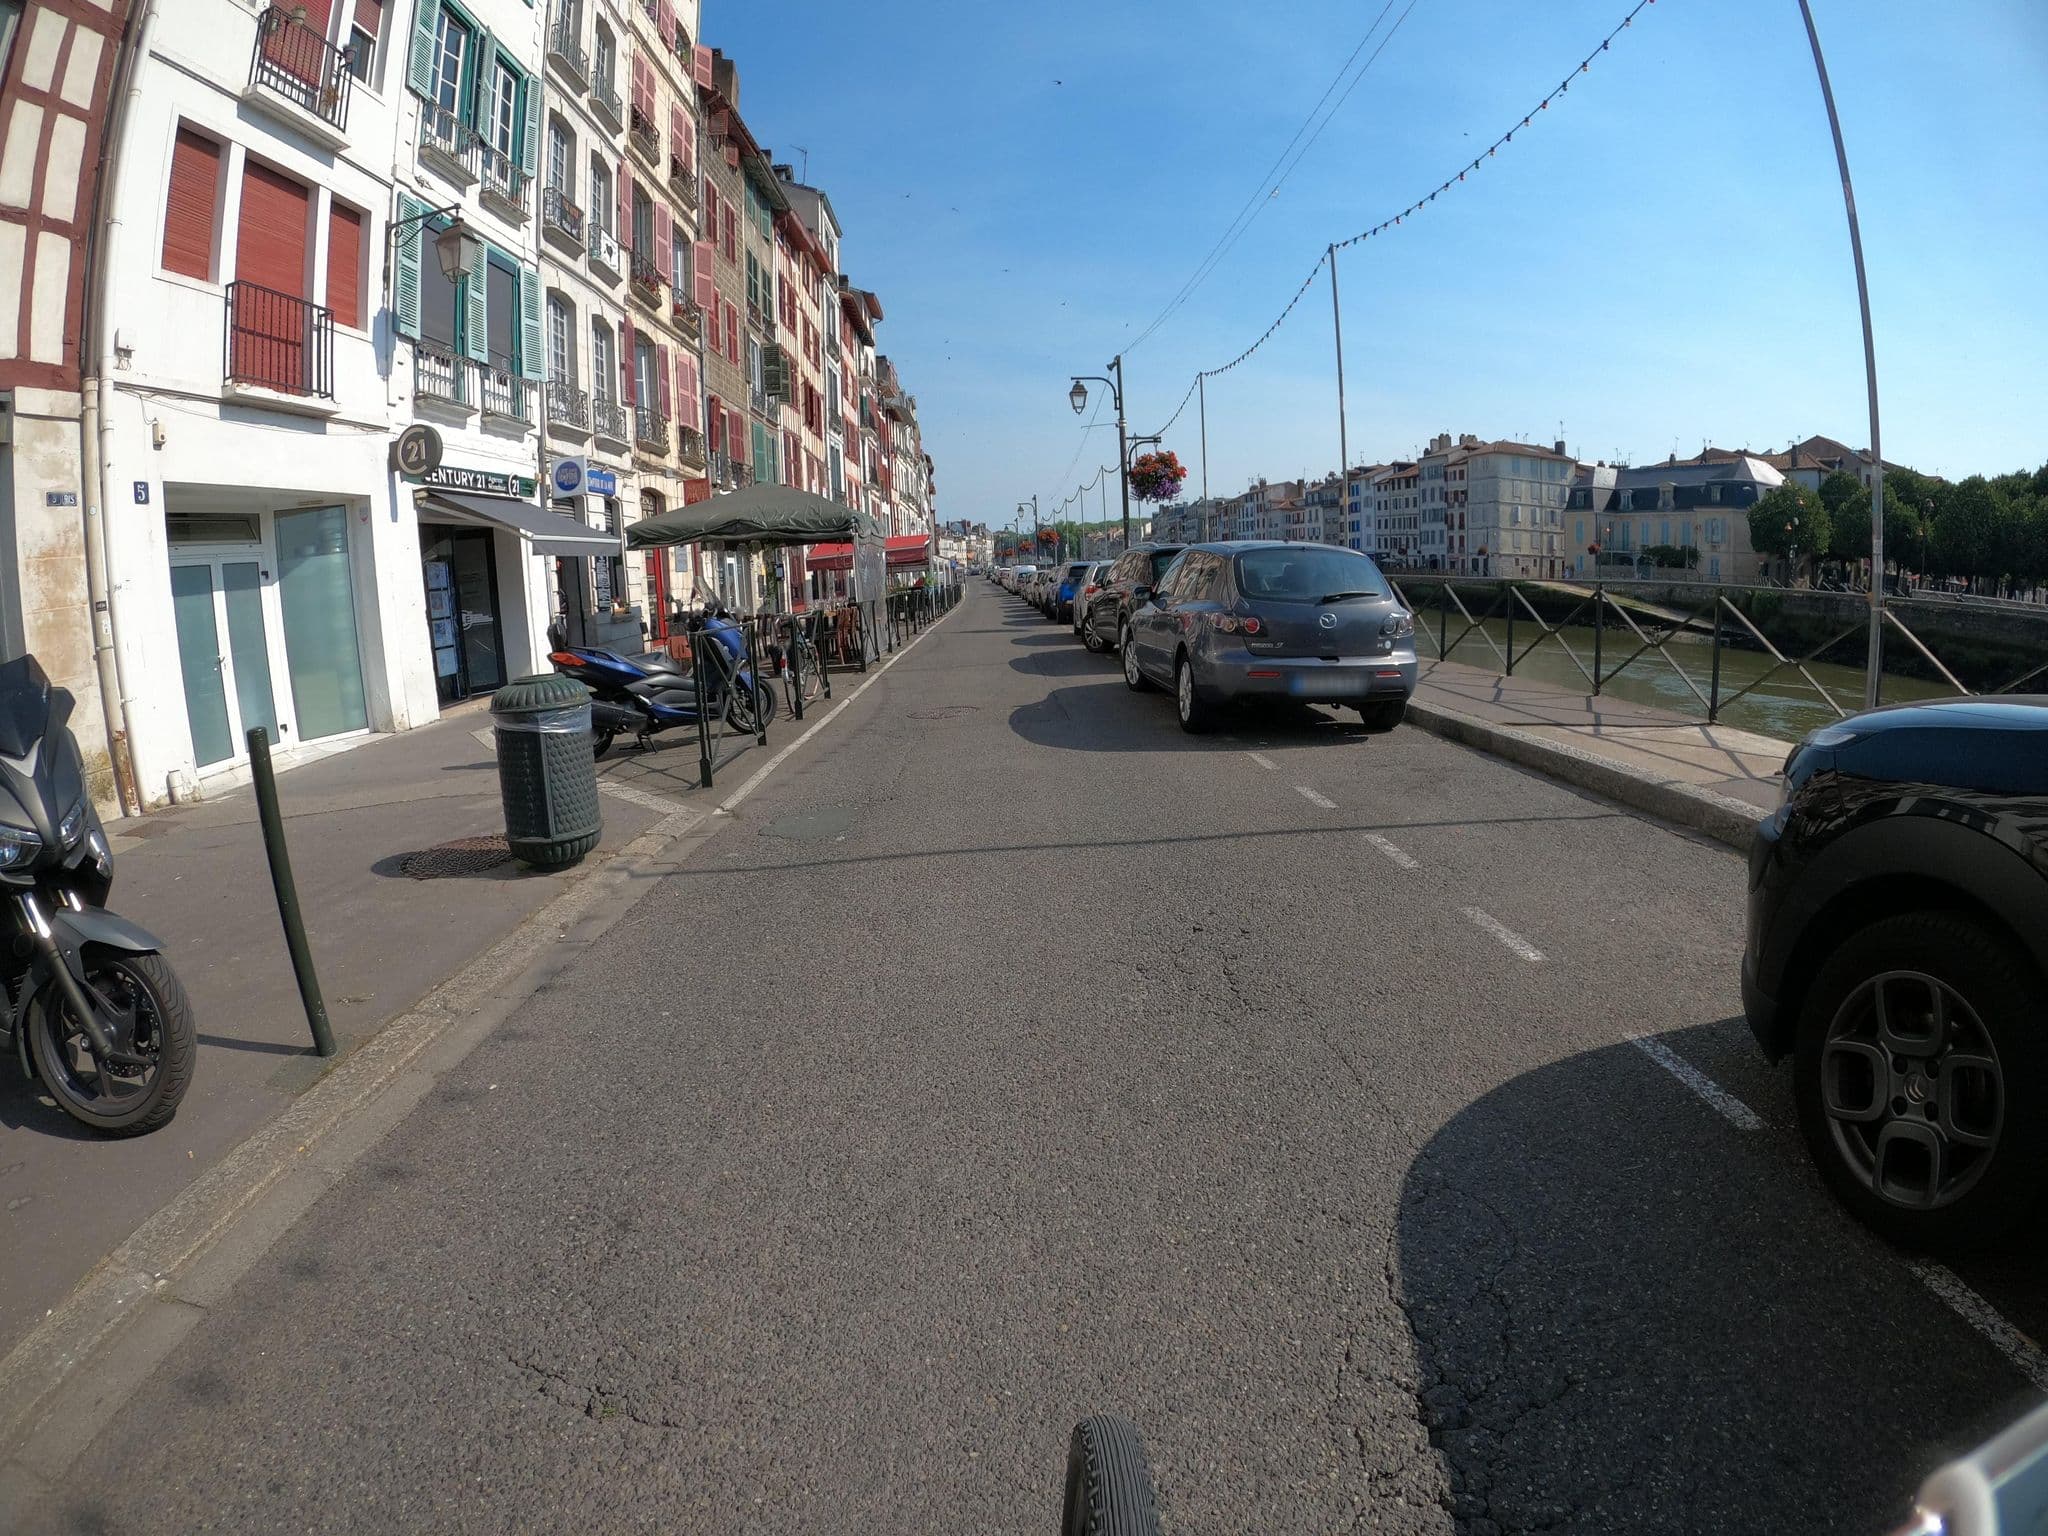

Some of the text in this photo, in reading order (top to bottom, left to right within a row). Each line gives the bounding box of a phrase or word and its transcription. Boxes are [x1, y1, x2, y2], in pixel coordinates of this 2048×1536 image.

[406, 438, 426, 463] 21
[476, 474, 486, 489] 21
[511, 479, 520, 493] 21
[137, 484, 146, 502] 5
